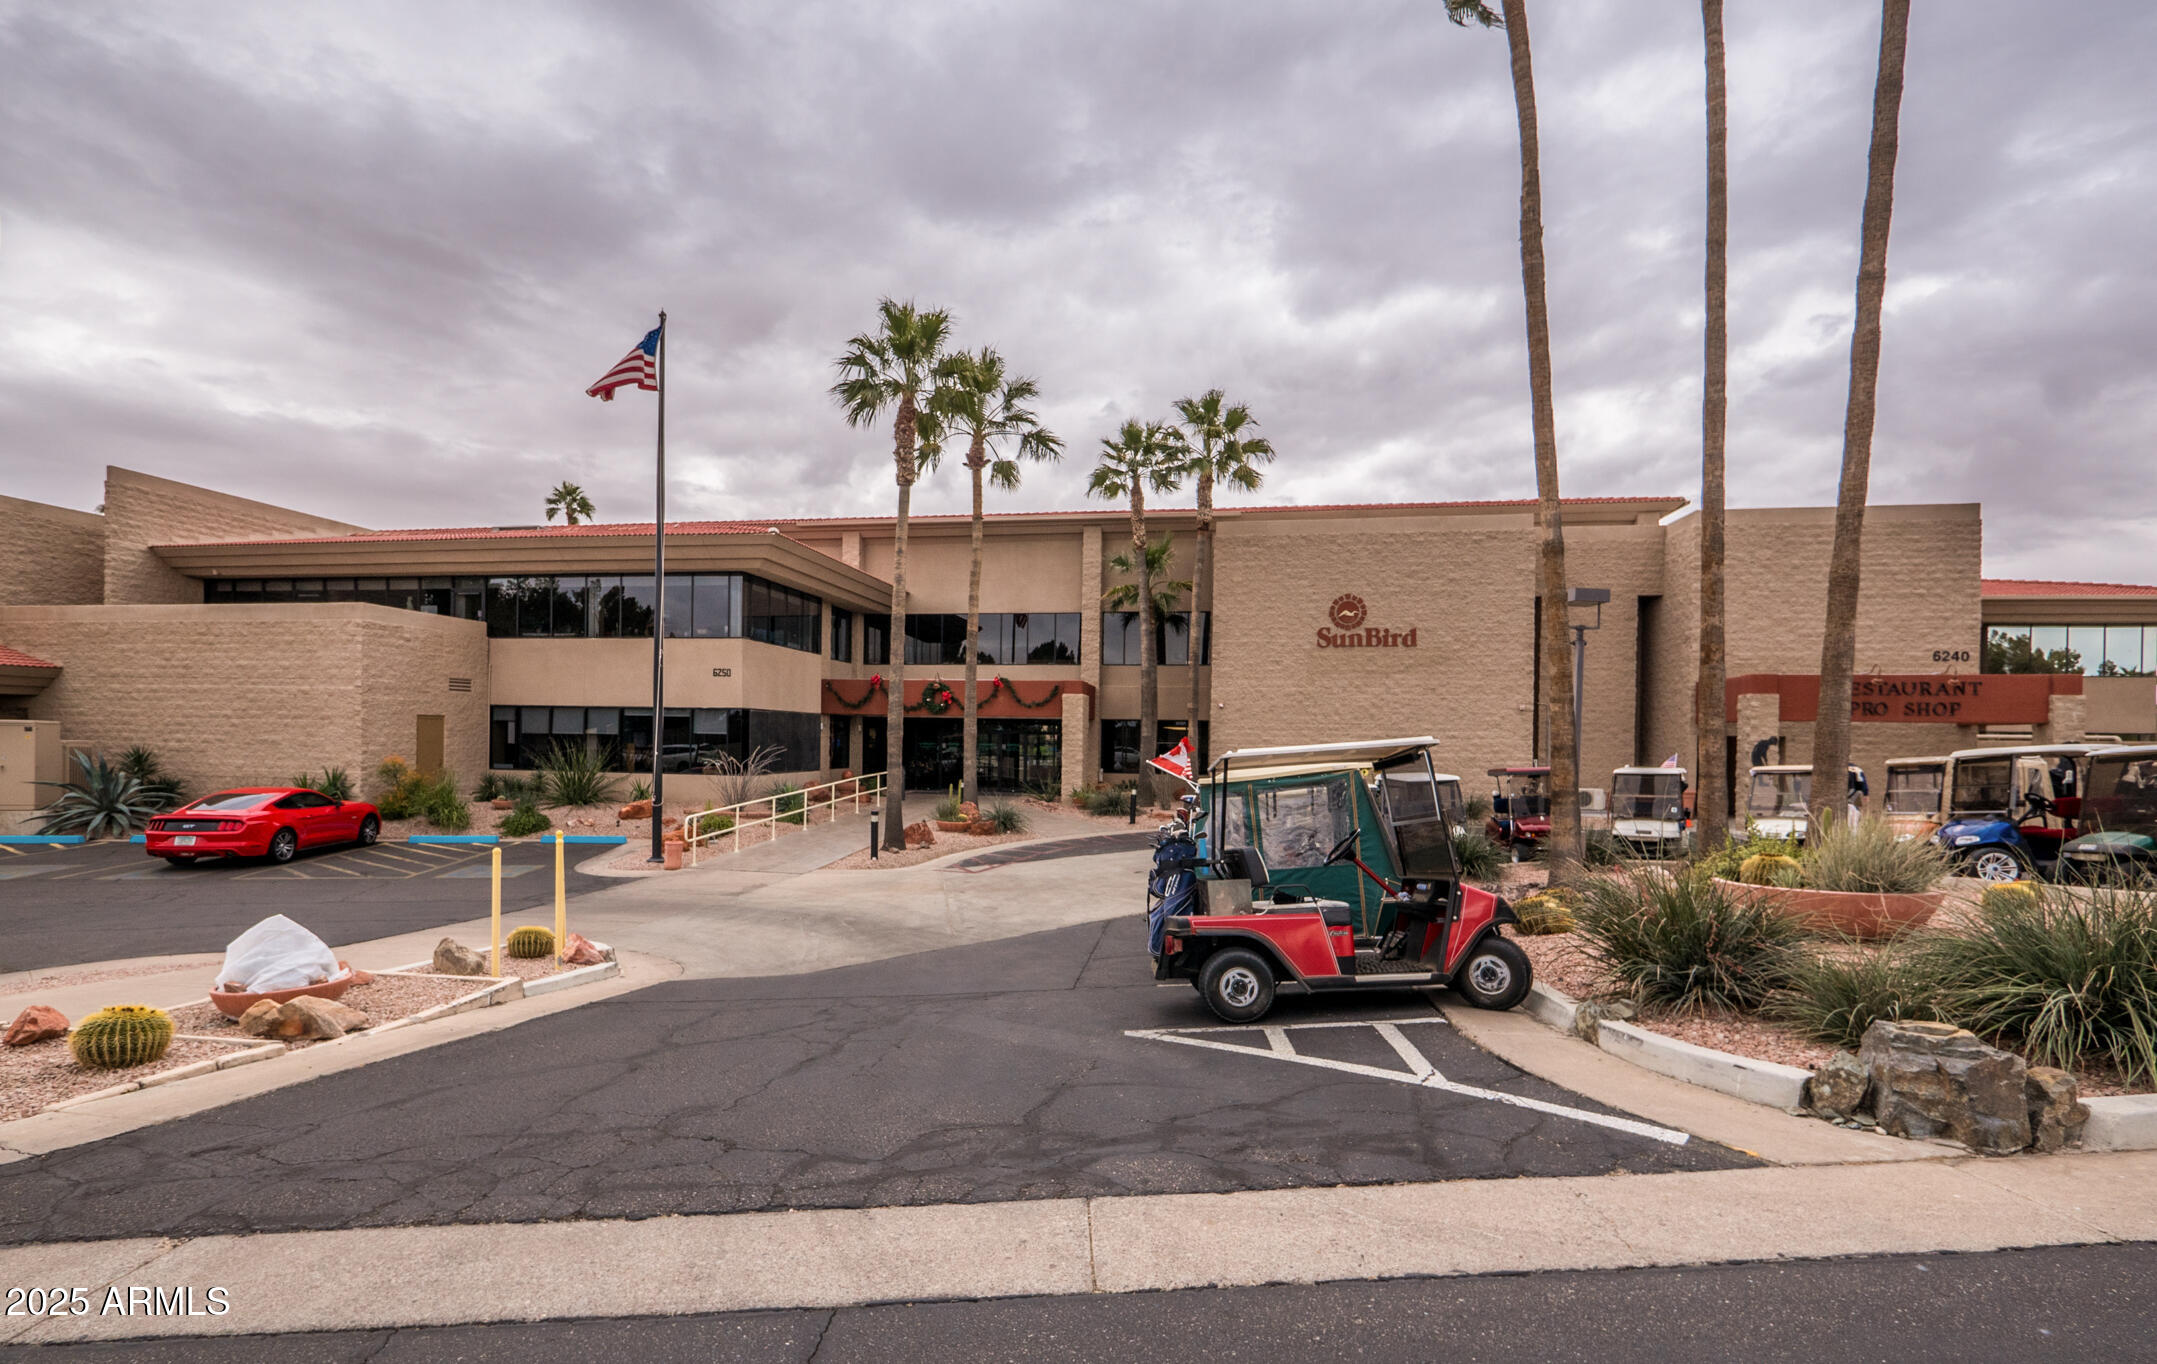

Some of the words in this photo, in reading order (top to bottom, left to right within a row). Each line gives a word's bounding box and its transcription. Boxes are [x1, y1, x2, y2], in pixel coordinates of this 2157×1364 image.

[1316, 626, 1418, 648] SunBird
[1932, 650, 1971, 663] 6240
[712, 667, 732, 678] 6250
[1851, 681, 1984, 697] ESTAURANT
[1851, 702, 1889, 717] PRO
[1903, 702, 1962, 717] SHOP
